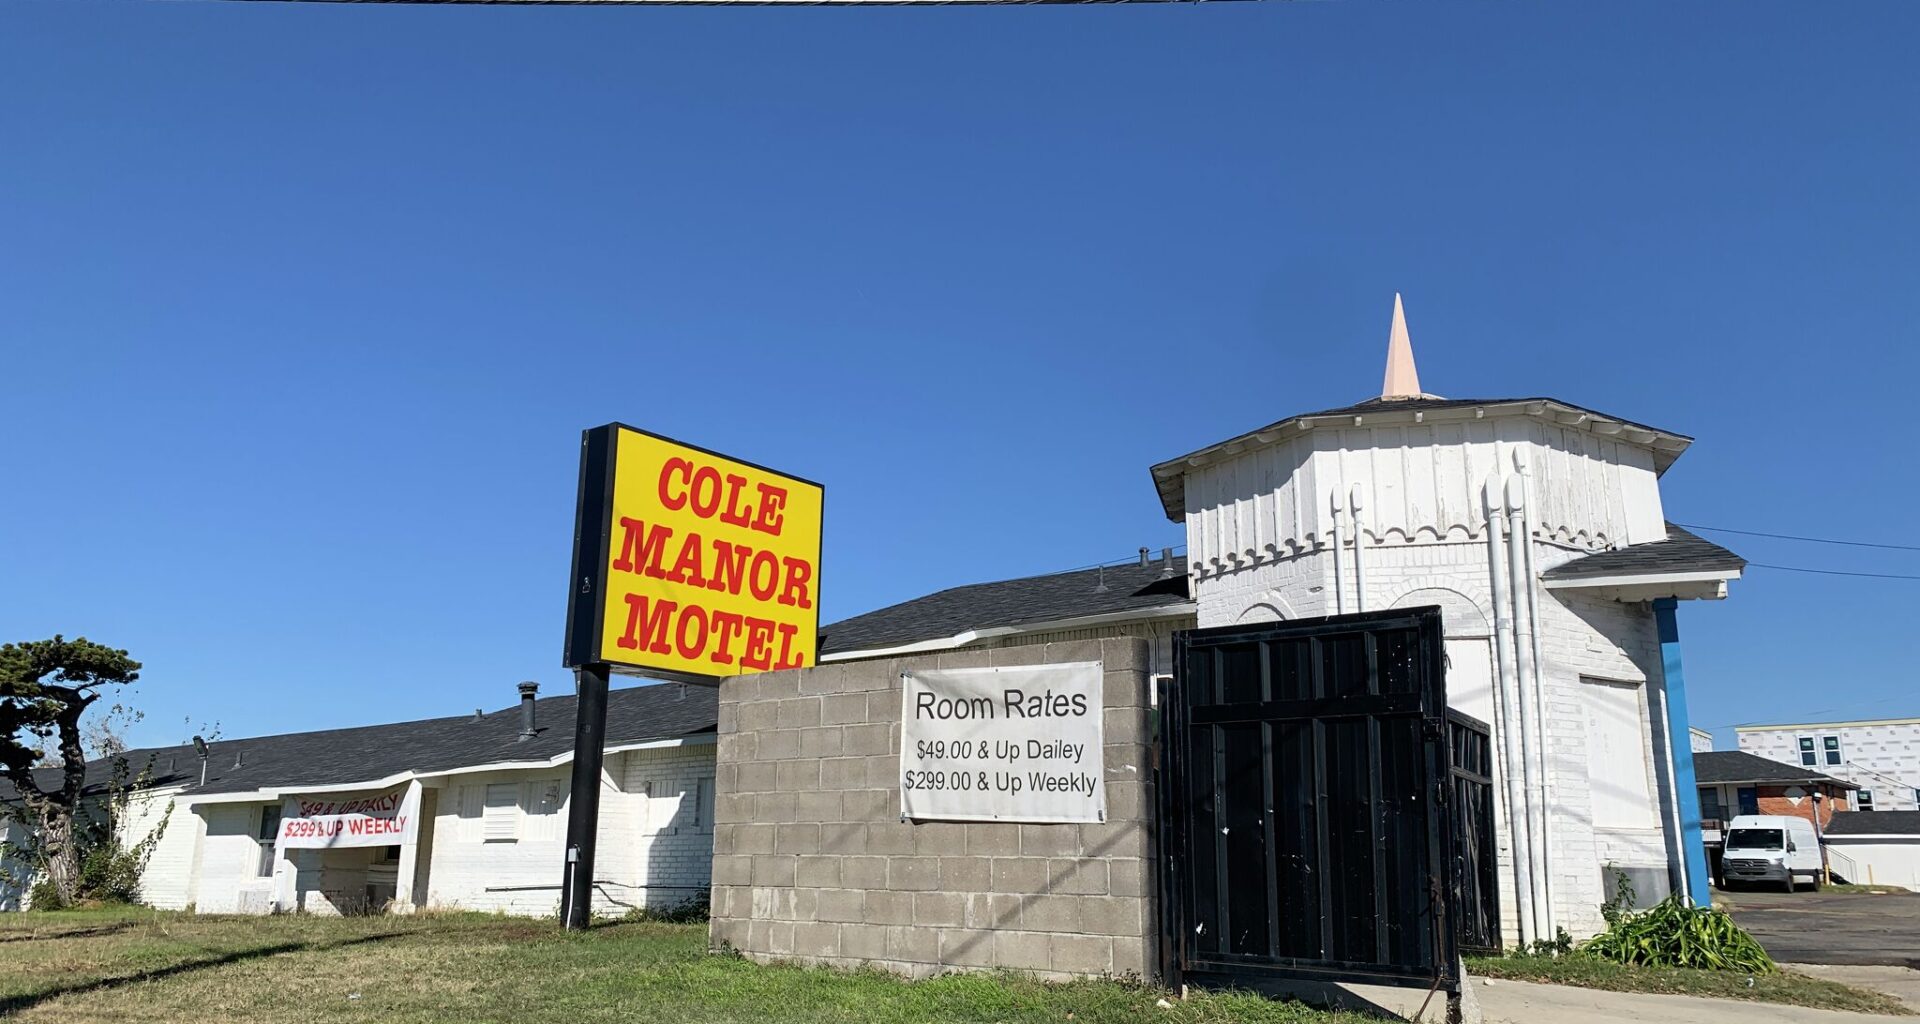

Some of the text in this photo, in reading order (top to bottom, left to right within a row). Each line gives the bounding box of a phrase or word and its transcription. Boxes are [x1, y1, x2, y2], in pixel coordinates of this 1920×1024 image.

[658, 456, 788, 537] COLE
[612, 516, 812, 610] MANOR
[616, 593, 805, 671] MOTEL
[916, 688, 1088, 720] Room Rates
[917, 739, 1084, 764] $49.00 & Up Dailey
[905, 770, 1097, 798] $299.00 & Up Weekly
[300, 801, 321, 817] $49
[285, 816, 407, 838] $299 & UP WEEKLY
